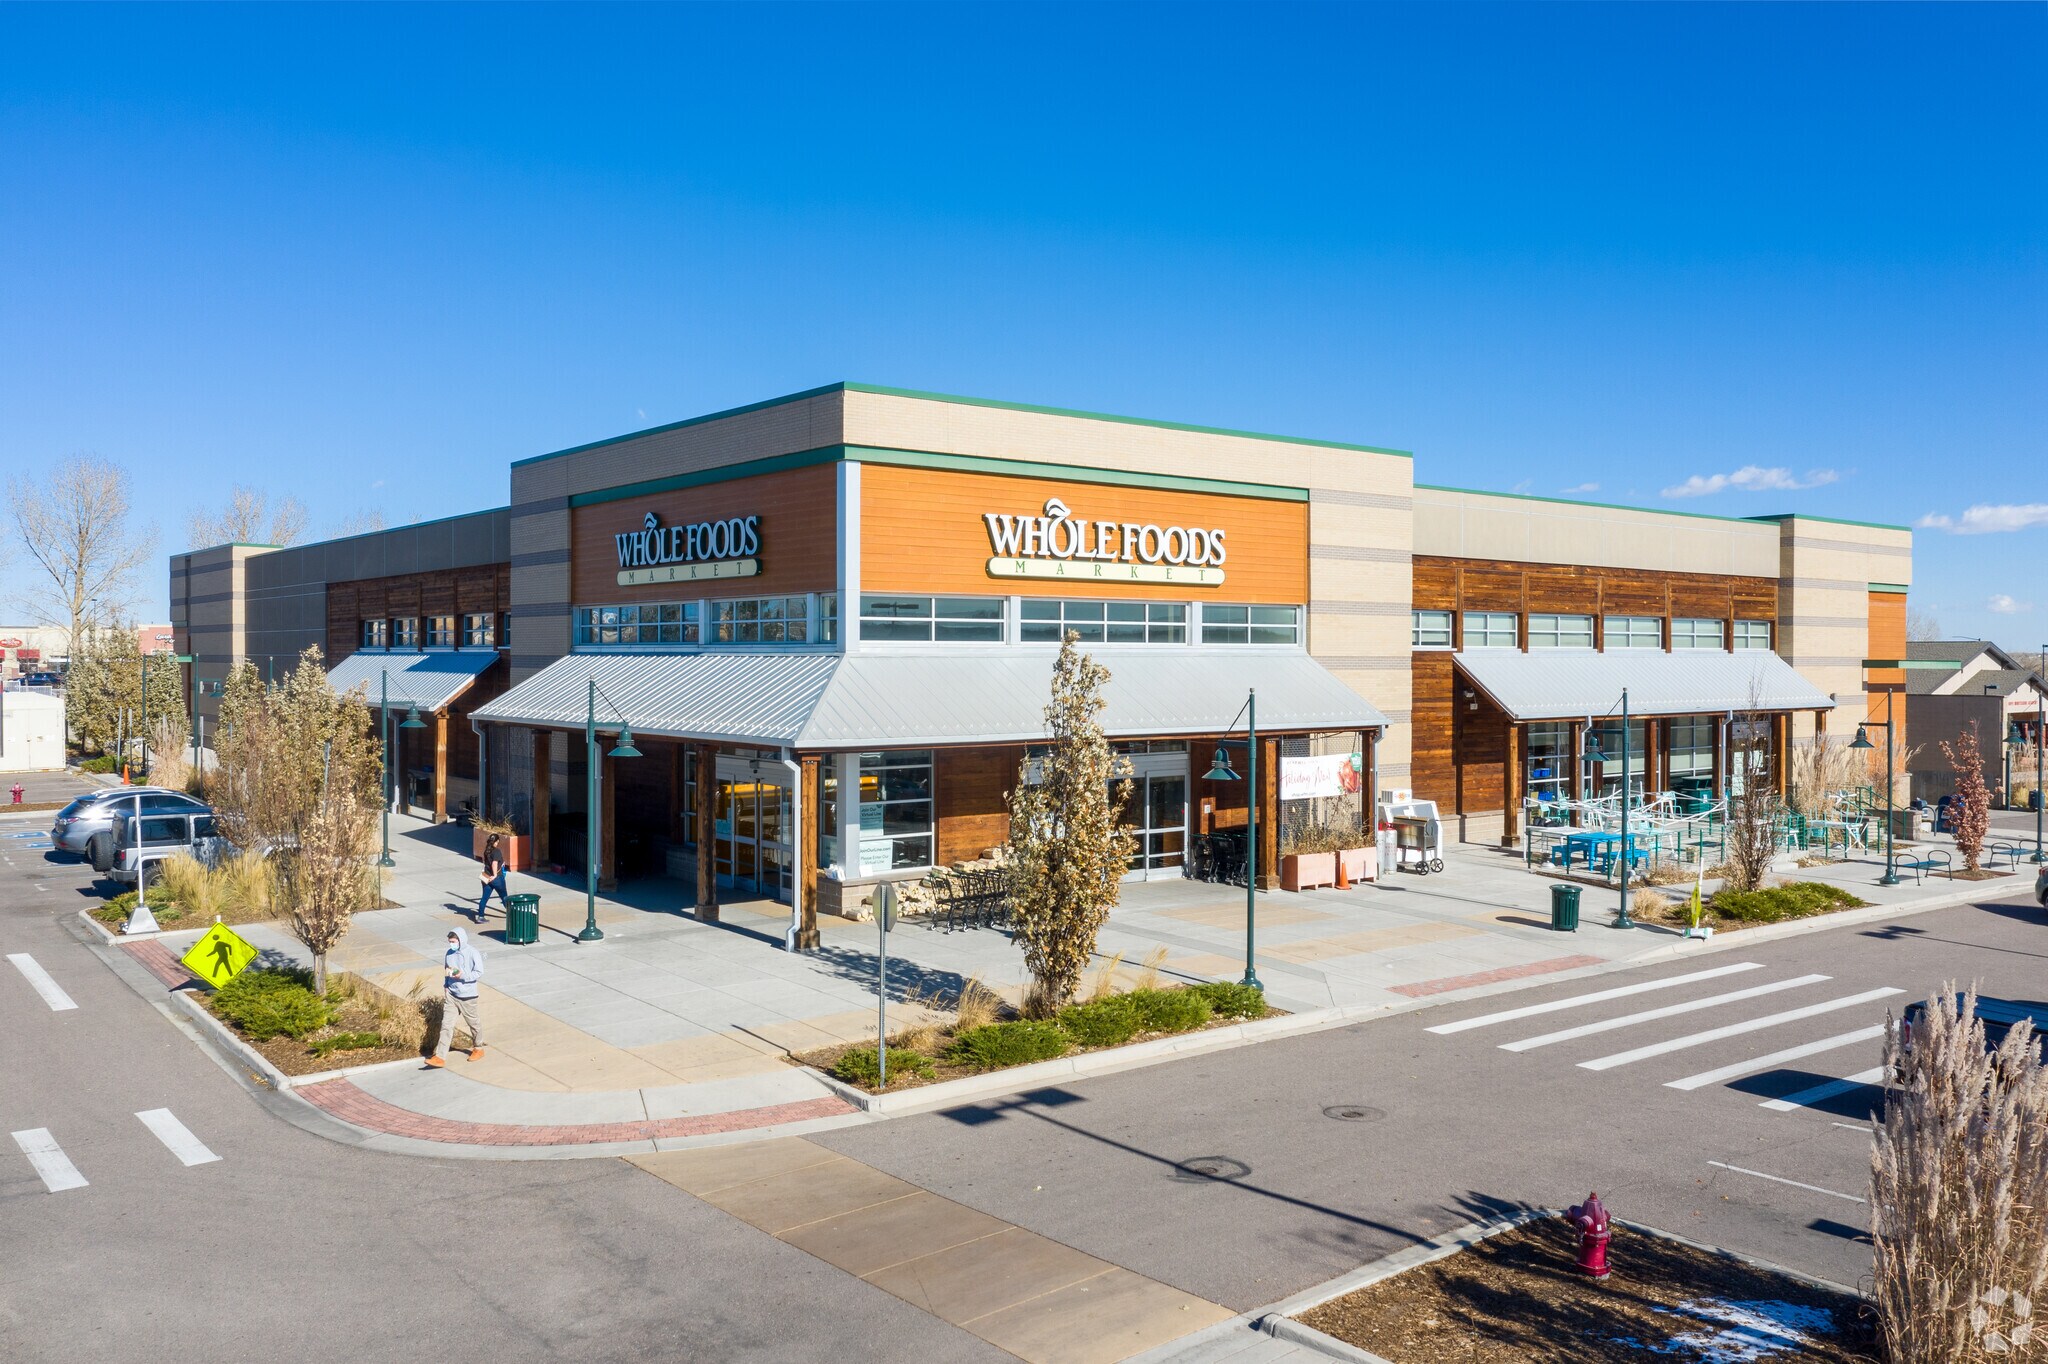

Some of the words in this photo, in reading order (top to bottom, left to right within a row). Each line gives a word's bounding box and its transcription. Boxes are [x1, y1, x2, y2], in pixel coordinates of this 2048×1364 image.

[615, 518, 684, 567] WHOLE
[685, 515, 758, 560] FOODS
[983, 504, 1117, 560] WHOLE
[1121, 521, 1226, 566] FOODS
[628, 561, 743, 584] MARKET
[1014, 559, 1206, 582] MARKET
